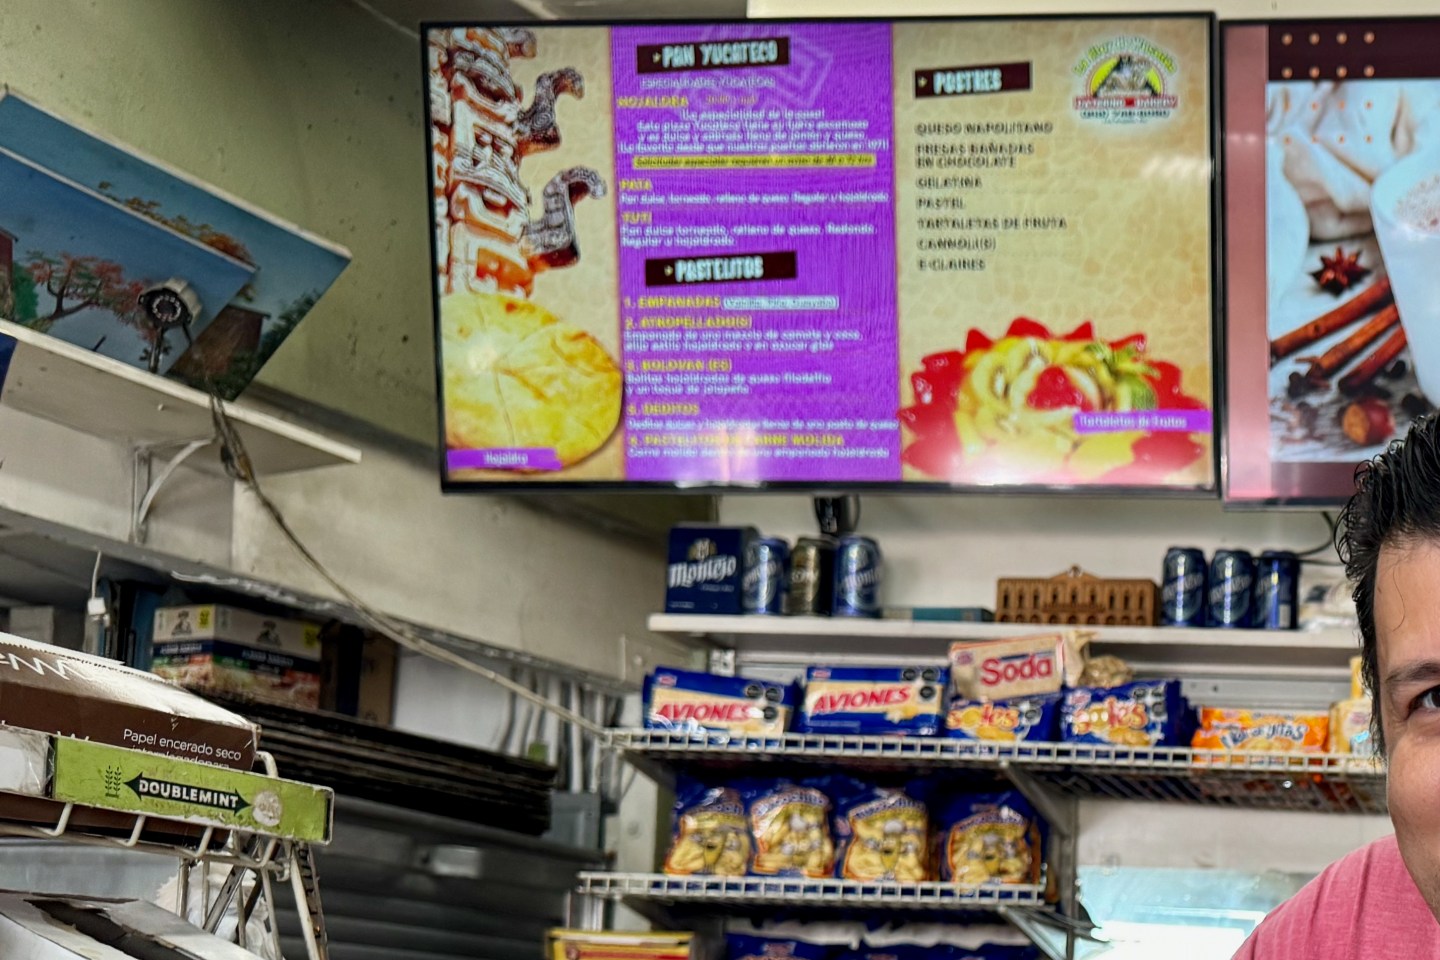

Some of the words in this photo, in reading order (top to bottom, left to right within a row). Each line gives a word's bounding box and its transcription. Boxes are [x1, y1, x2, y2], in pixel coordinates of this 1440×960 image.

[662, 44, 695, 68] PAN
[700, 40, 778, 66] YUCATECO
[932, 67, 1003, 95] POSTRES
[674, 255, 764, 284] PASTELITOS
[668, 554, 737, 588] Montejo
[981, 653, 1053, 686] Soda
[655, 703, 752, 723] AVIONES
[812, 686, 912, 714] AVIONES
[123, 728, 157, 747] Papel
[159, 736, 213, 755] encerado
[215, 747, 242, 761] seco
[138, 779, 239, 809] DOUBLEMINT
